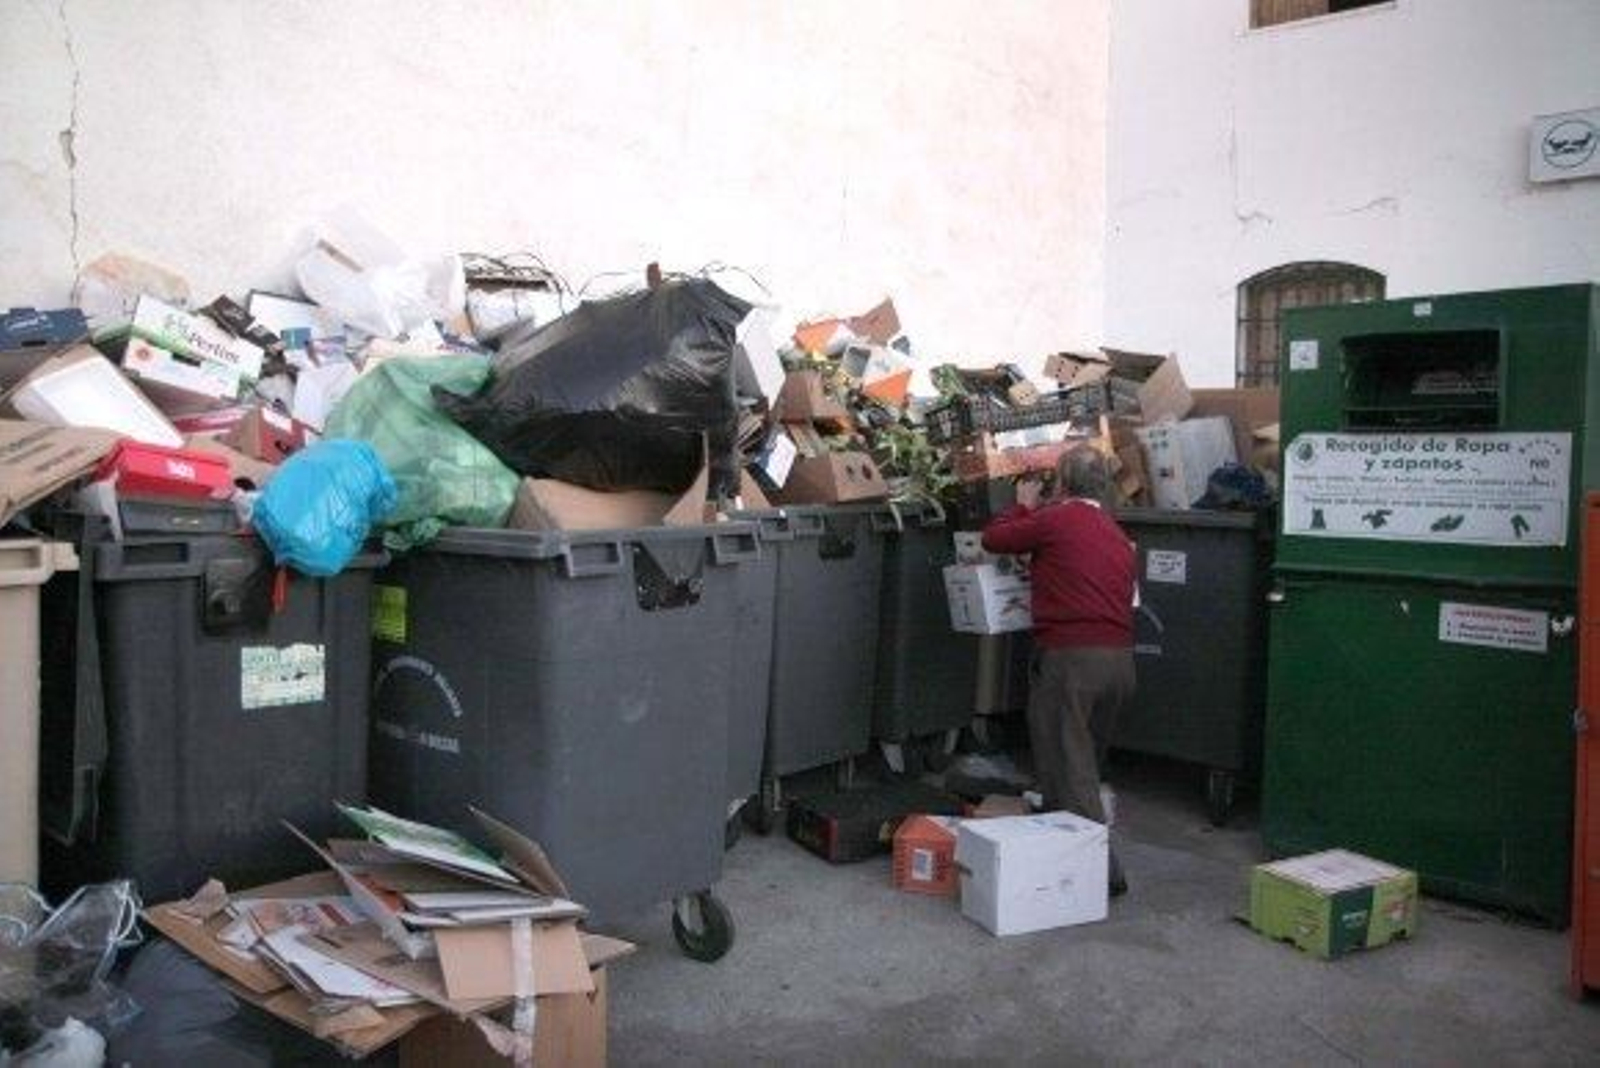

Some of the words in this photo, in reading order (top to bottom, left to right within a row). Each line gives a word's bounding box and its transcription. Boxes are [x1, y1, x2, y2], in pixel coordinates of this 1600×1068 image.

[1421, 437, 1448, 452] de
[1455, 437, 1510, 456] Ropa
[1364, 459, 1376, 472] y
